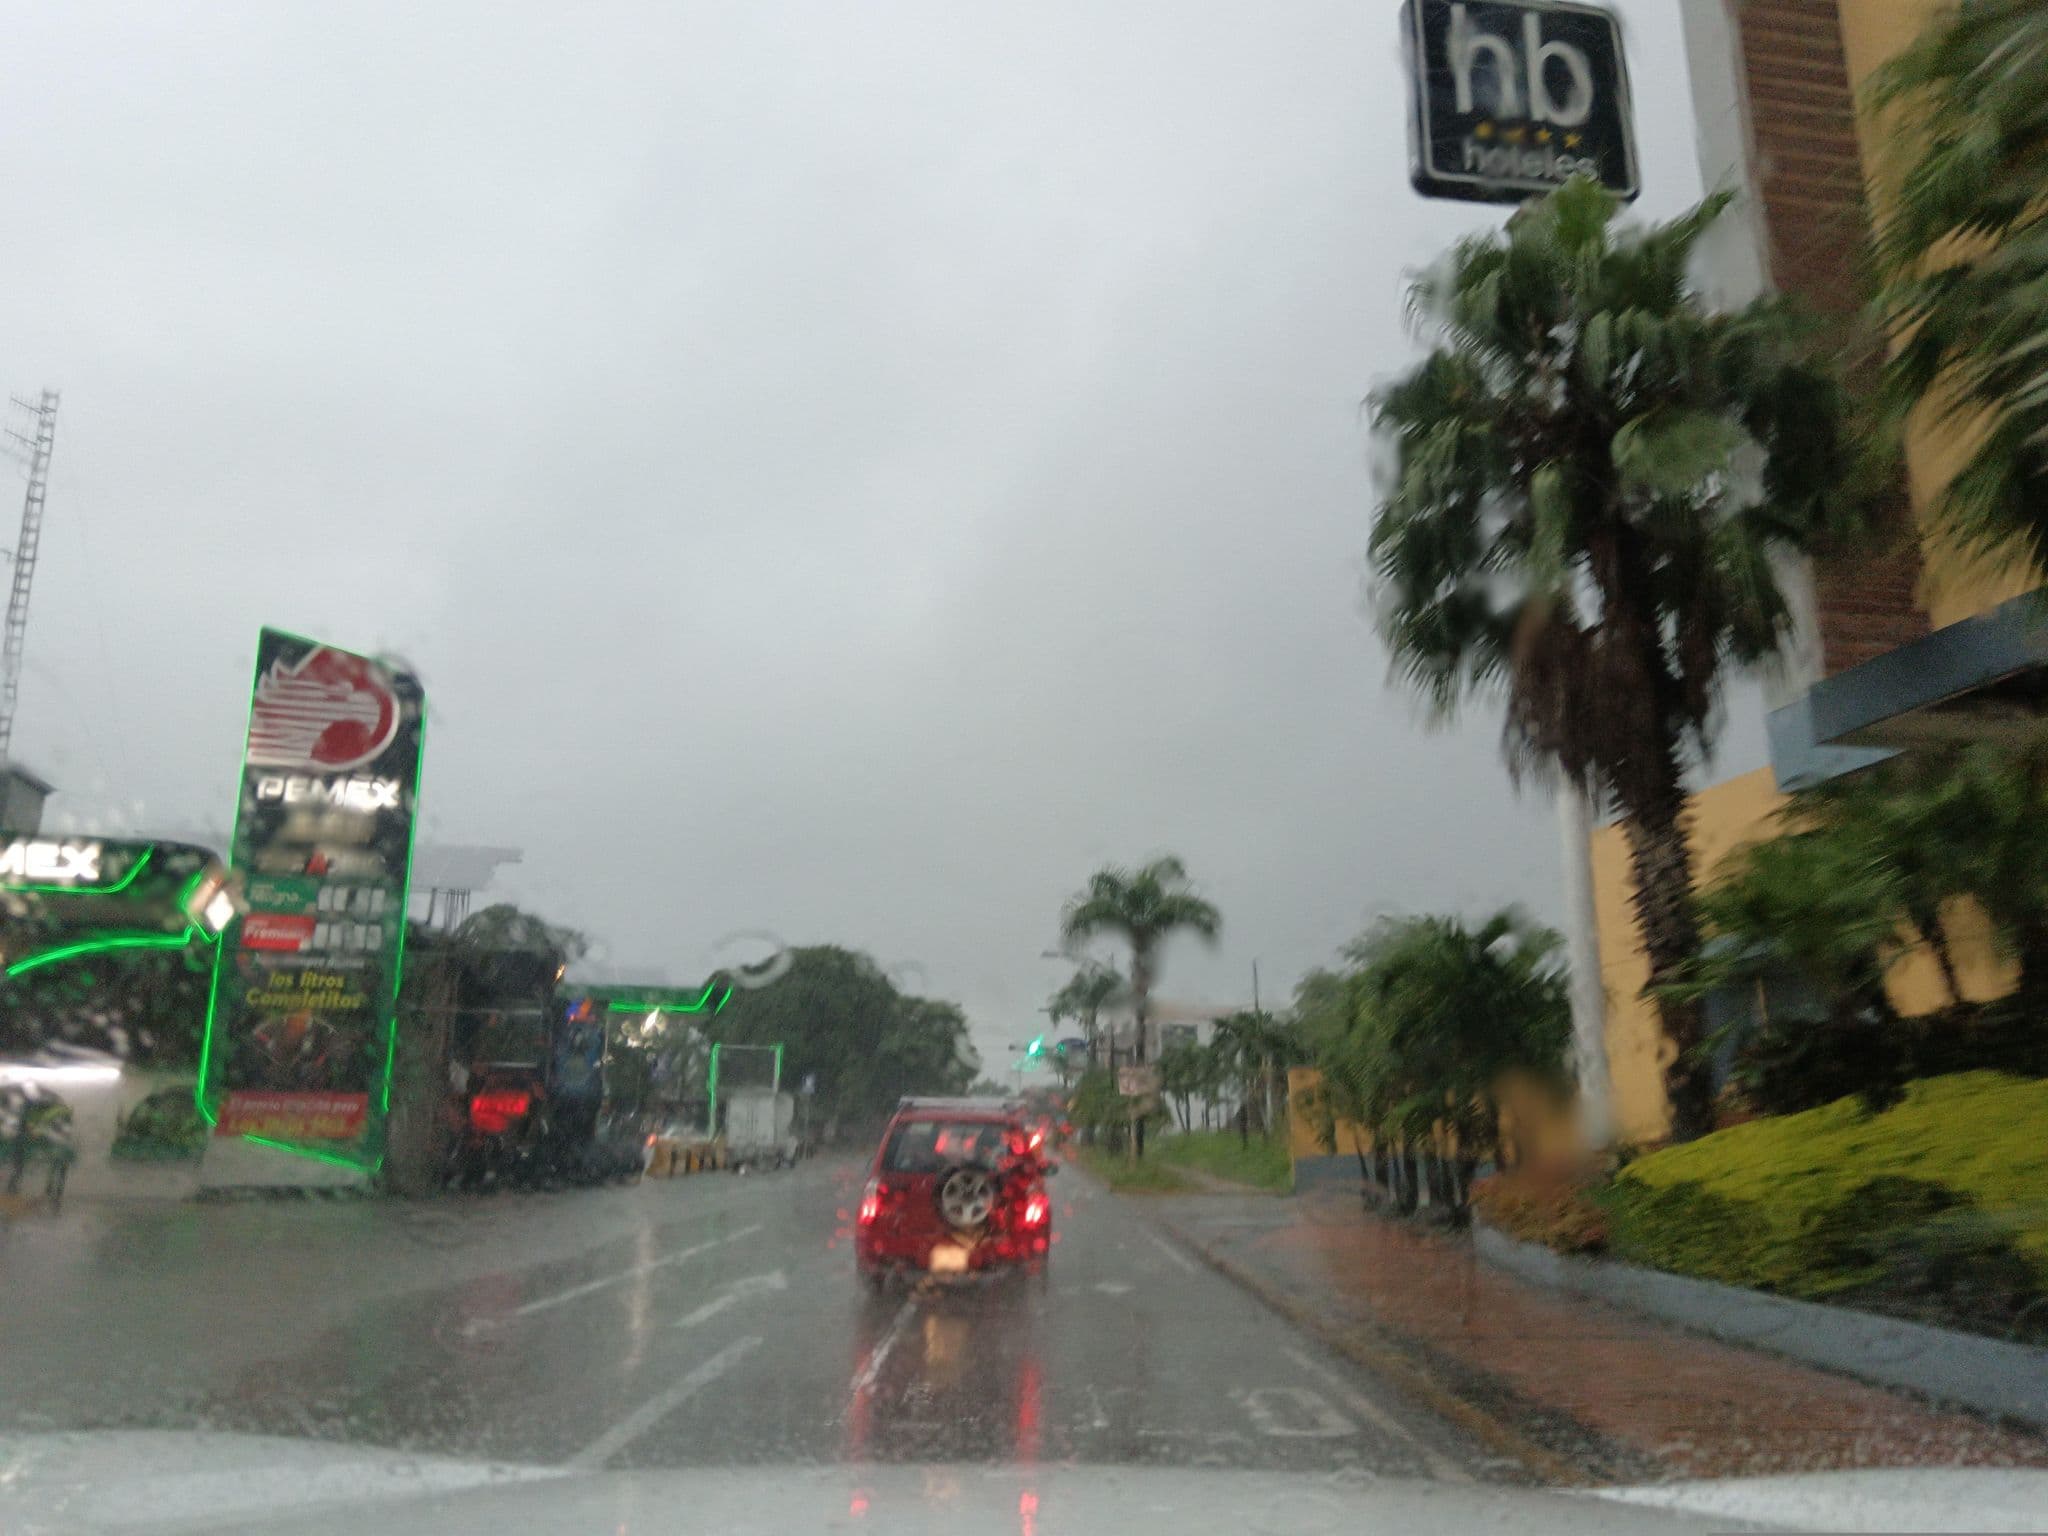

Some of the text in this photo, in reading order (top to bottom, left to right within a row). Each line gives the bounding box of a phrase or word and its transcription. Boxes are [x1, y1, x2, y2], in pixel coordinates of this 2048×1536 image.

[1446, 2, 1594, 127] hb
[1463, 136, 1598, 182] hoteles
[257, 774, 400, 812] PEMEX
